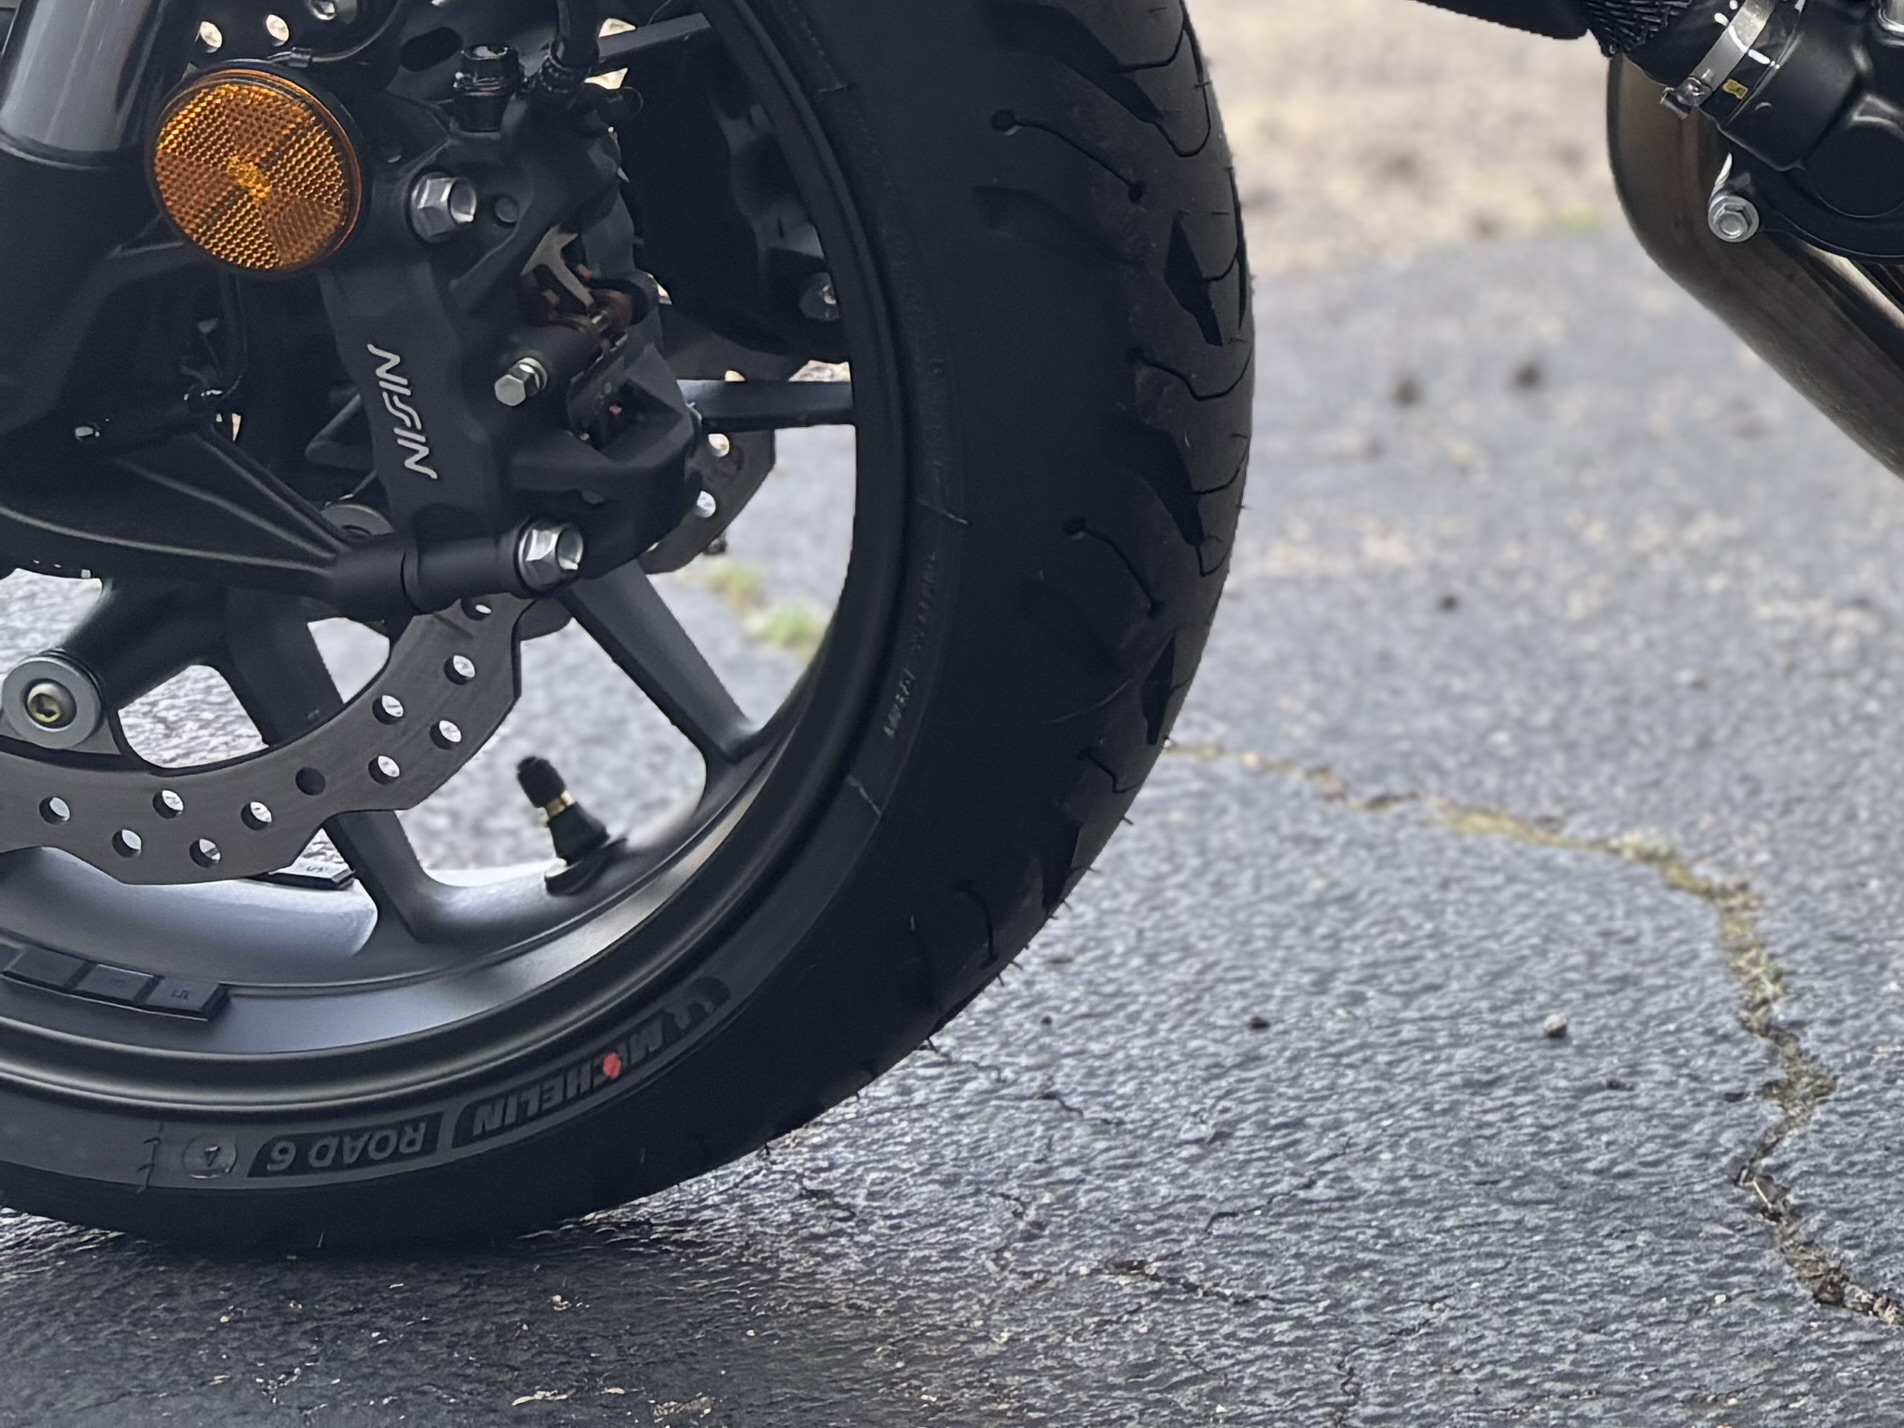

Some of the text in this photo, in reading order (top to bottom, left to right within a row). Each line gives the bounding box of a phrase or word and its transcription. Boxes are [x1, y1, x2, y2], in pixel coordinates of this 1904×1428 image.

[366, 343, 439, 480] NISSIN
[266, 1119, 428, 1172] ROAD 6
